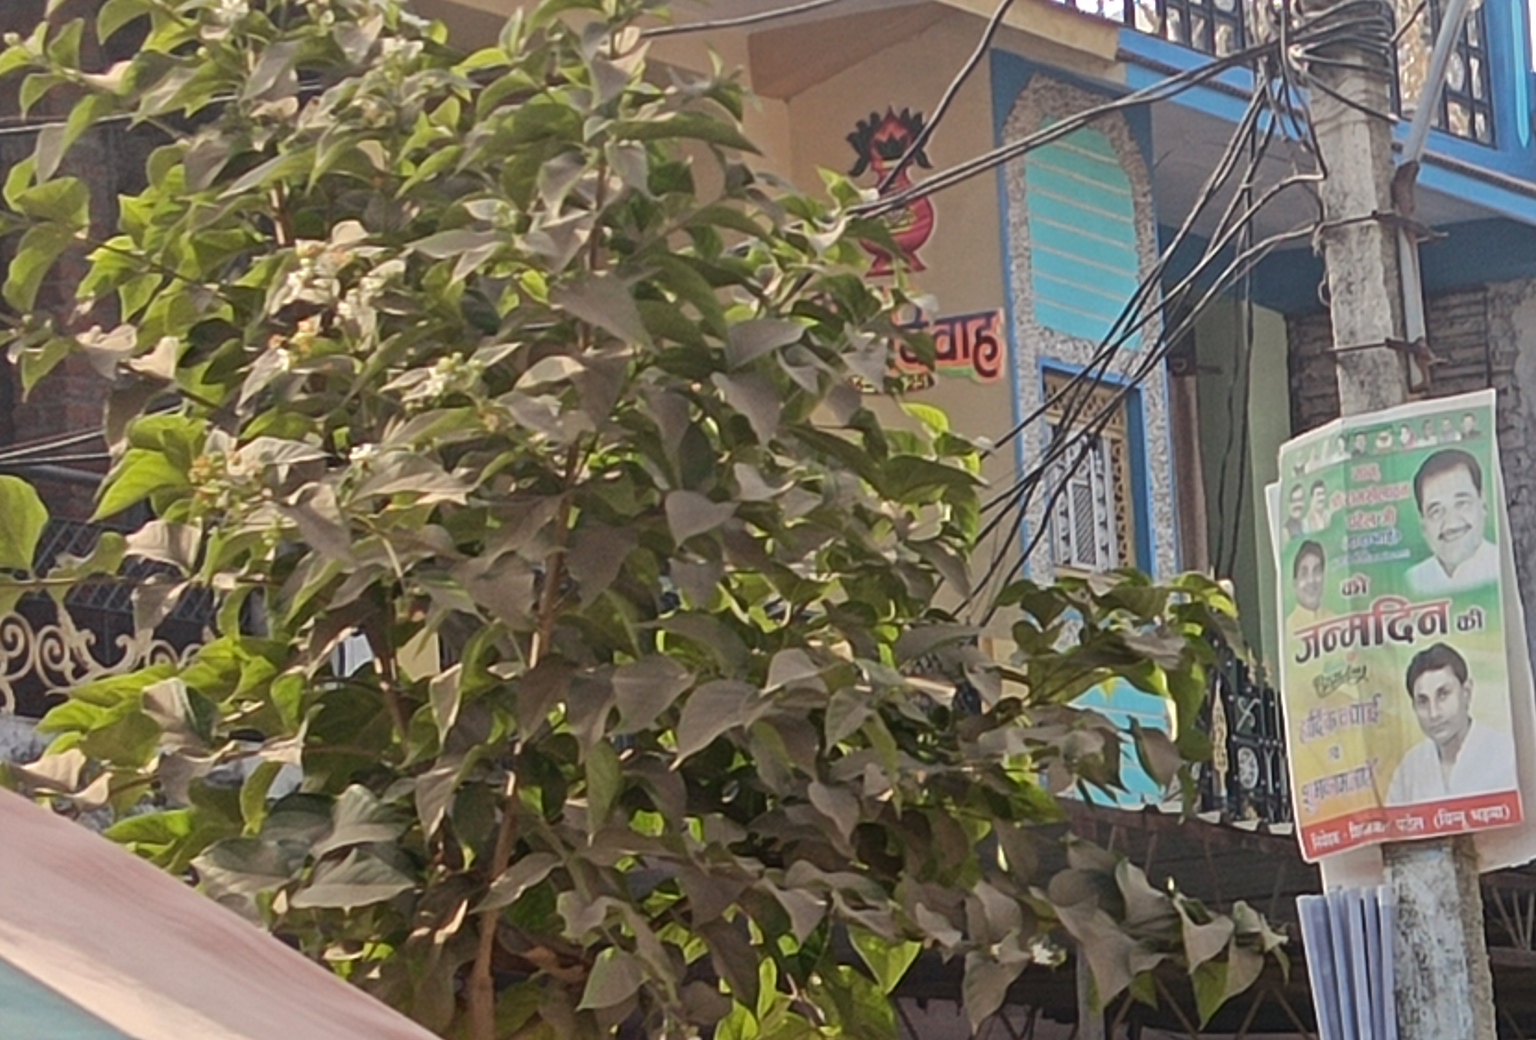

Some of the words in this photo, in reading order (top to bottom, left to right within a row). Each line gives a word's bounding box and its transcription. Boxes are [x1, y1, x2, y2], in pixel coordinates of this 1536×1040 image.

[1341, 572, 1368, 597] को
[1293, 595, 1453, 665] जन्मदिन
[1456, 608, 1484, 632] की
